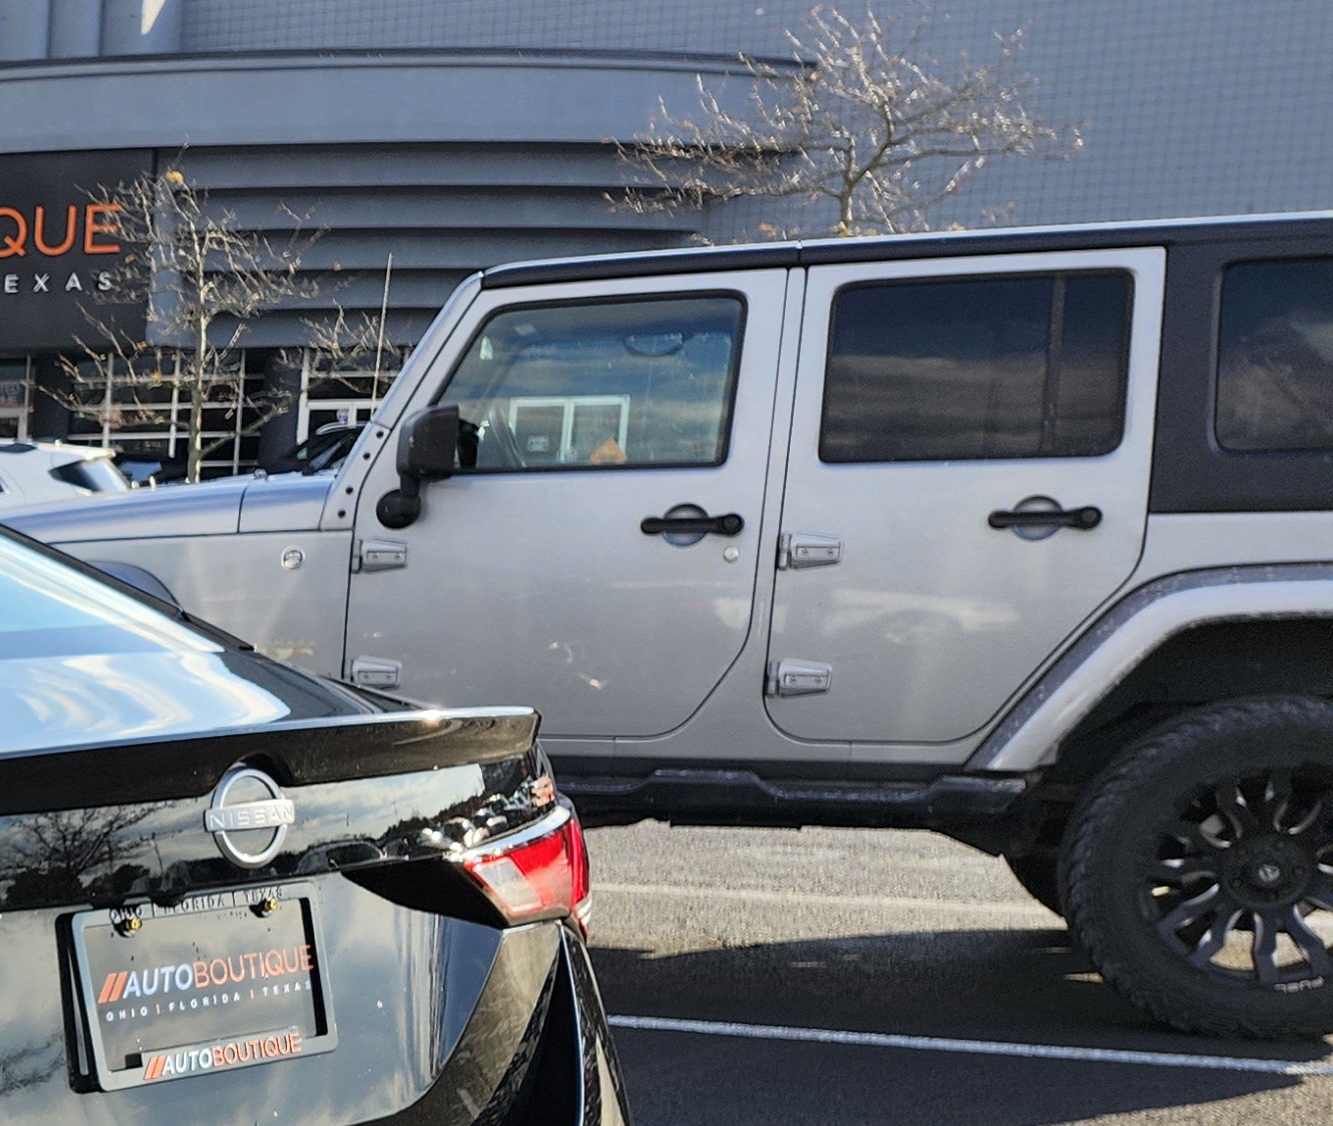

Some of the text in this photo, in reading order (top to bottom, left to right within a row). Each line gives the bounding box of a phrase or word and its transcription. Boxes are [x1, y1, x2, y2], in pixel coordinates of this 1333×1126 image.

[209, 805, 293, 829] NISSAN
[122, 944, 314, 999] AUTOBOUTIQUE
[106, 981, 311, 1022] OHIO FLORIDA TEXAS
[162, 1032, 302, 1076] AUTOBOUTIQUE
